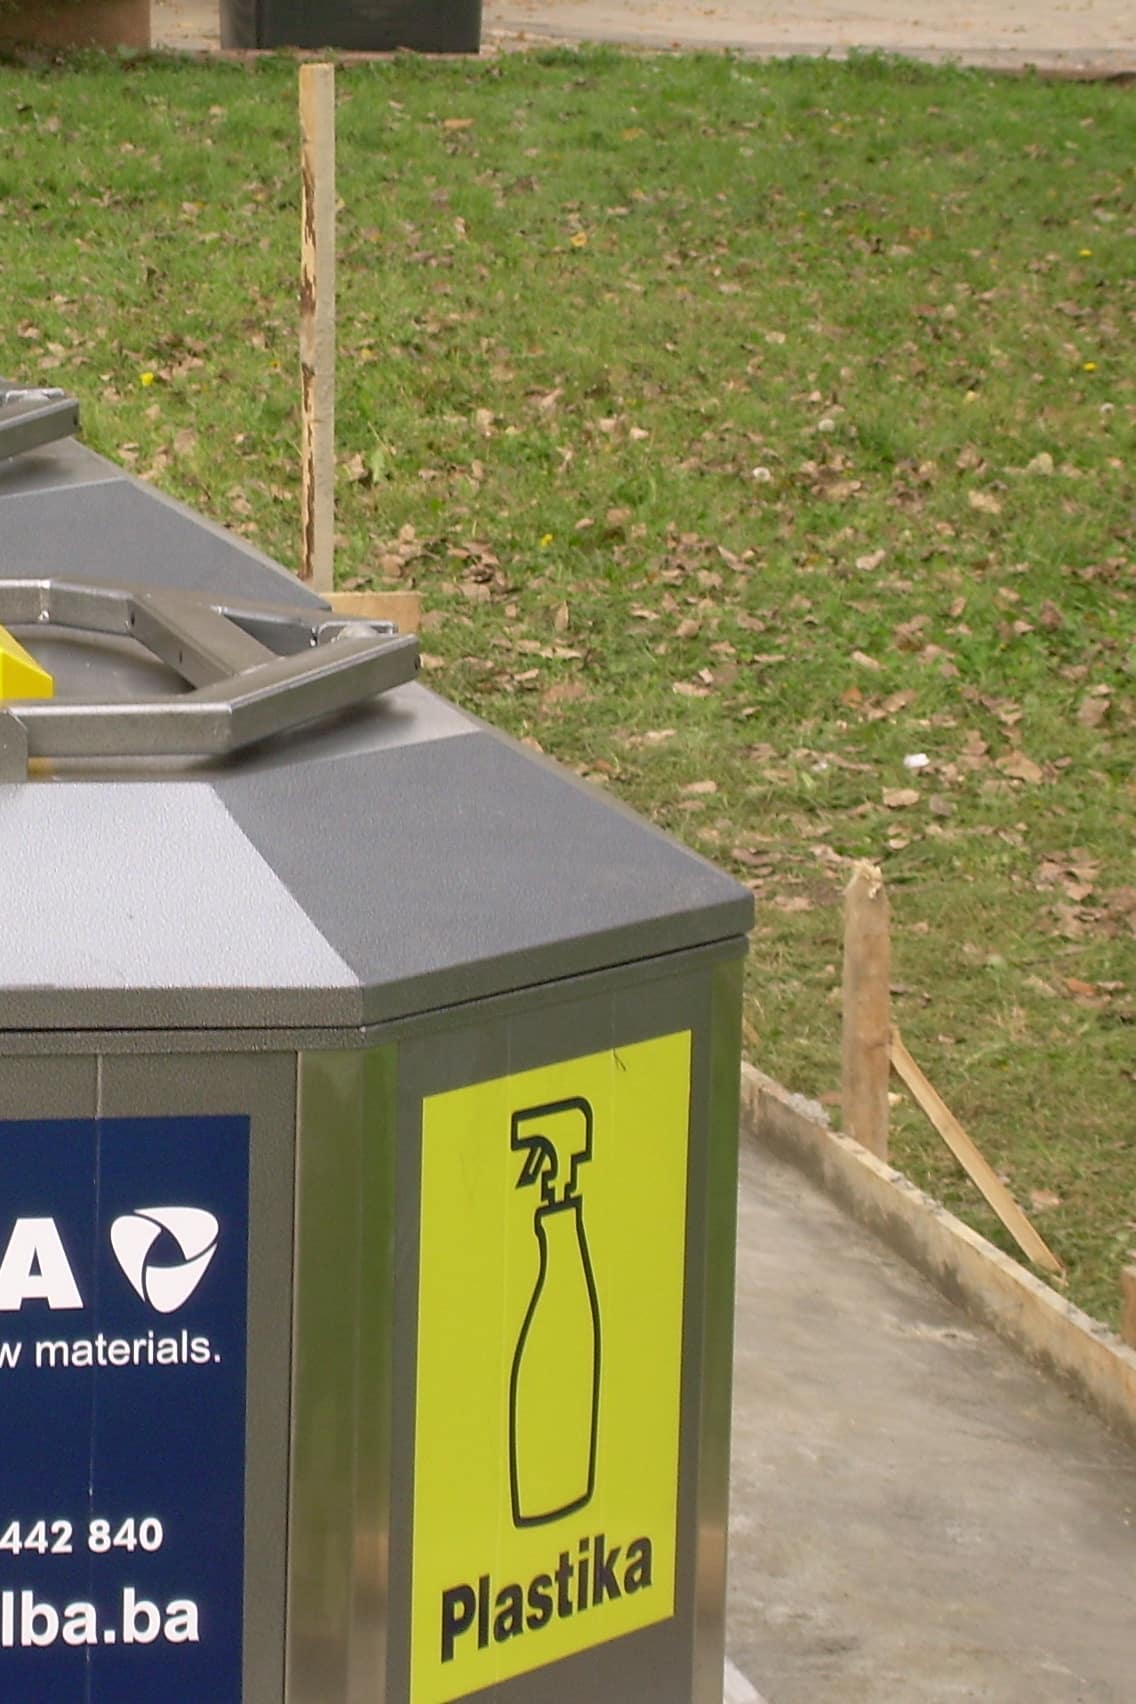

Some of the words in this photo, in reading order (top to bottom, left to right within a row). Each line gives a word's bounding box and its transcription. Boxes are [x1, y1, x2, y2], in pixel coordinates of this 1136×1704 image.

[36, 1330, 220, 1367] materials.
[0, 1520, 72, 1554] 442
[88, 1517, 163, 1552] 840
[441, 1533, 652, 1664] Plastika
